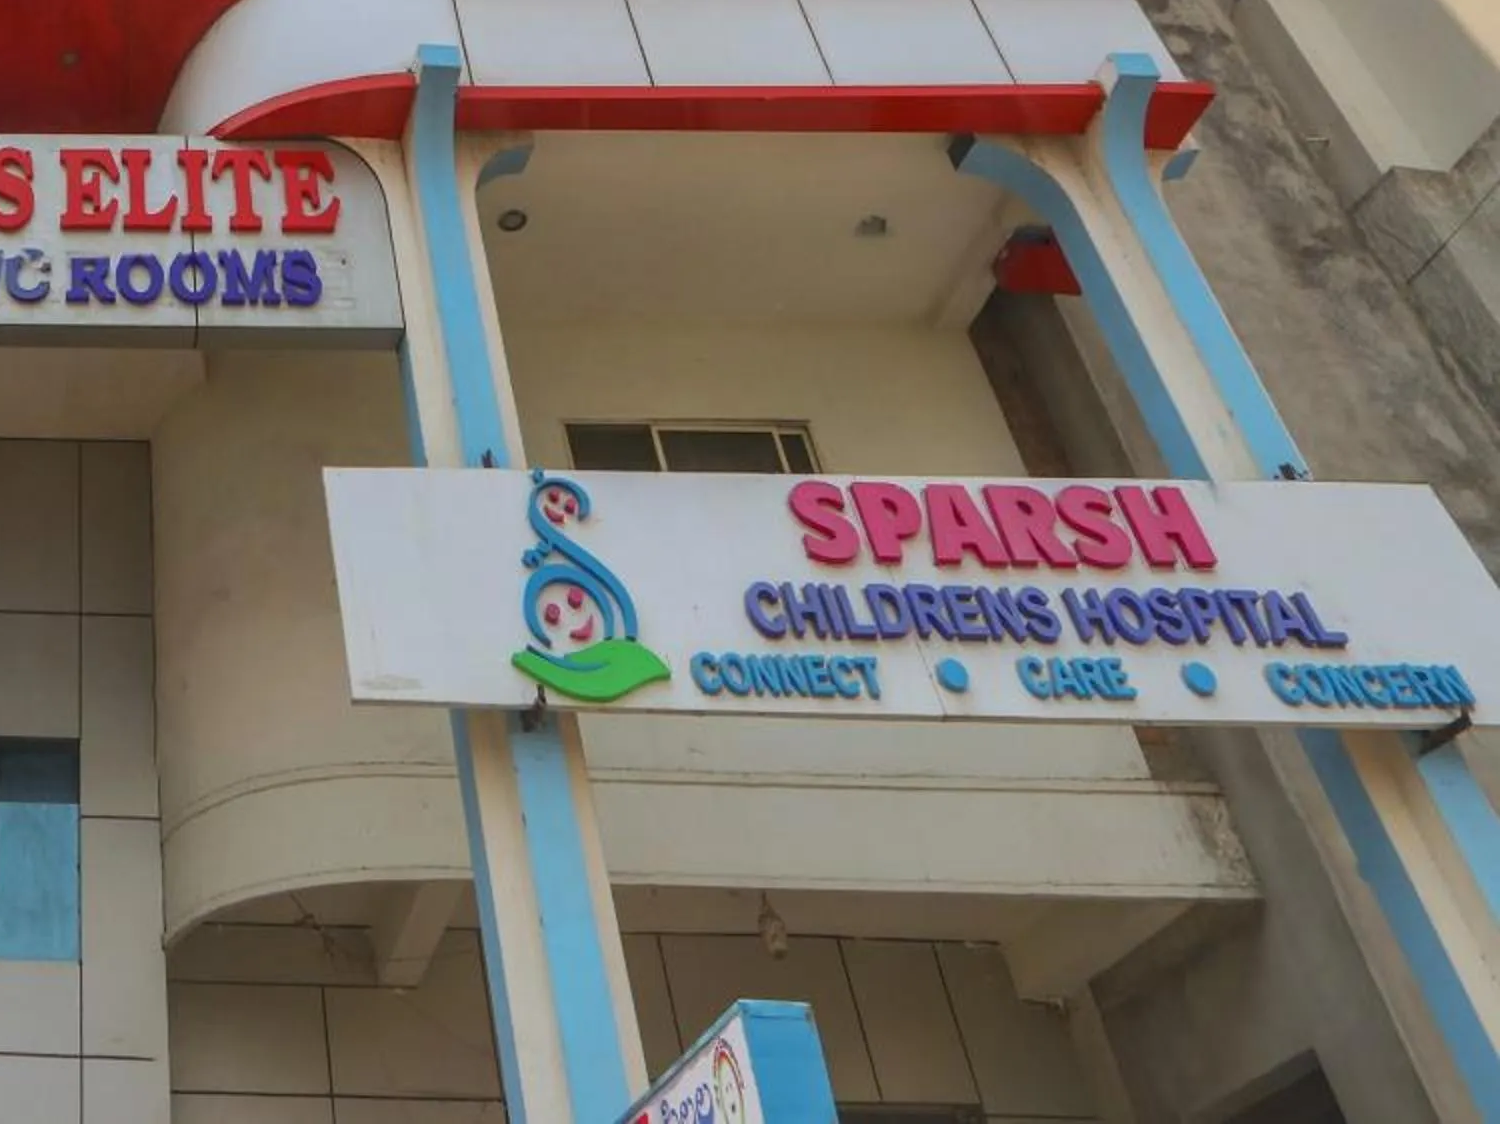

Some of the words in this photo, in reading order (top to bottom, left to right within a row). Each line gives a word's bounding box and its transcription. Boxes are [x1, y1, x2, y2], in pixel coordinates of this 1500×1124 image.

[59, 148, 341, 234] ELITE
[65, 249, 323, 307] ROOMS
[788, 481, 1218, 569] SPARSH
[744, 581, 1062, 643] CHILDRENS
[1063, 585, 1349, 649] HOSPITAL
[691, 652, 879, 700] CONNECT
[1017, 657, 1137, 700] CARE
[1264, 661, 1475, 709] CONCERN
